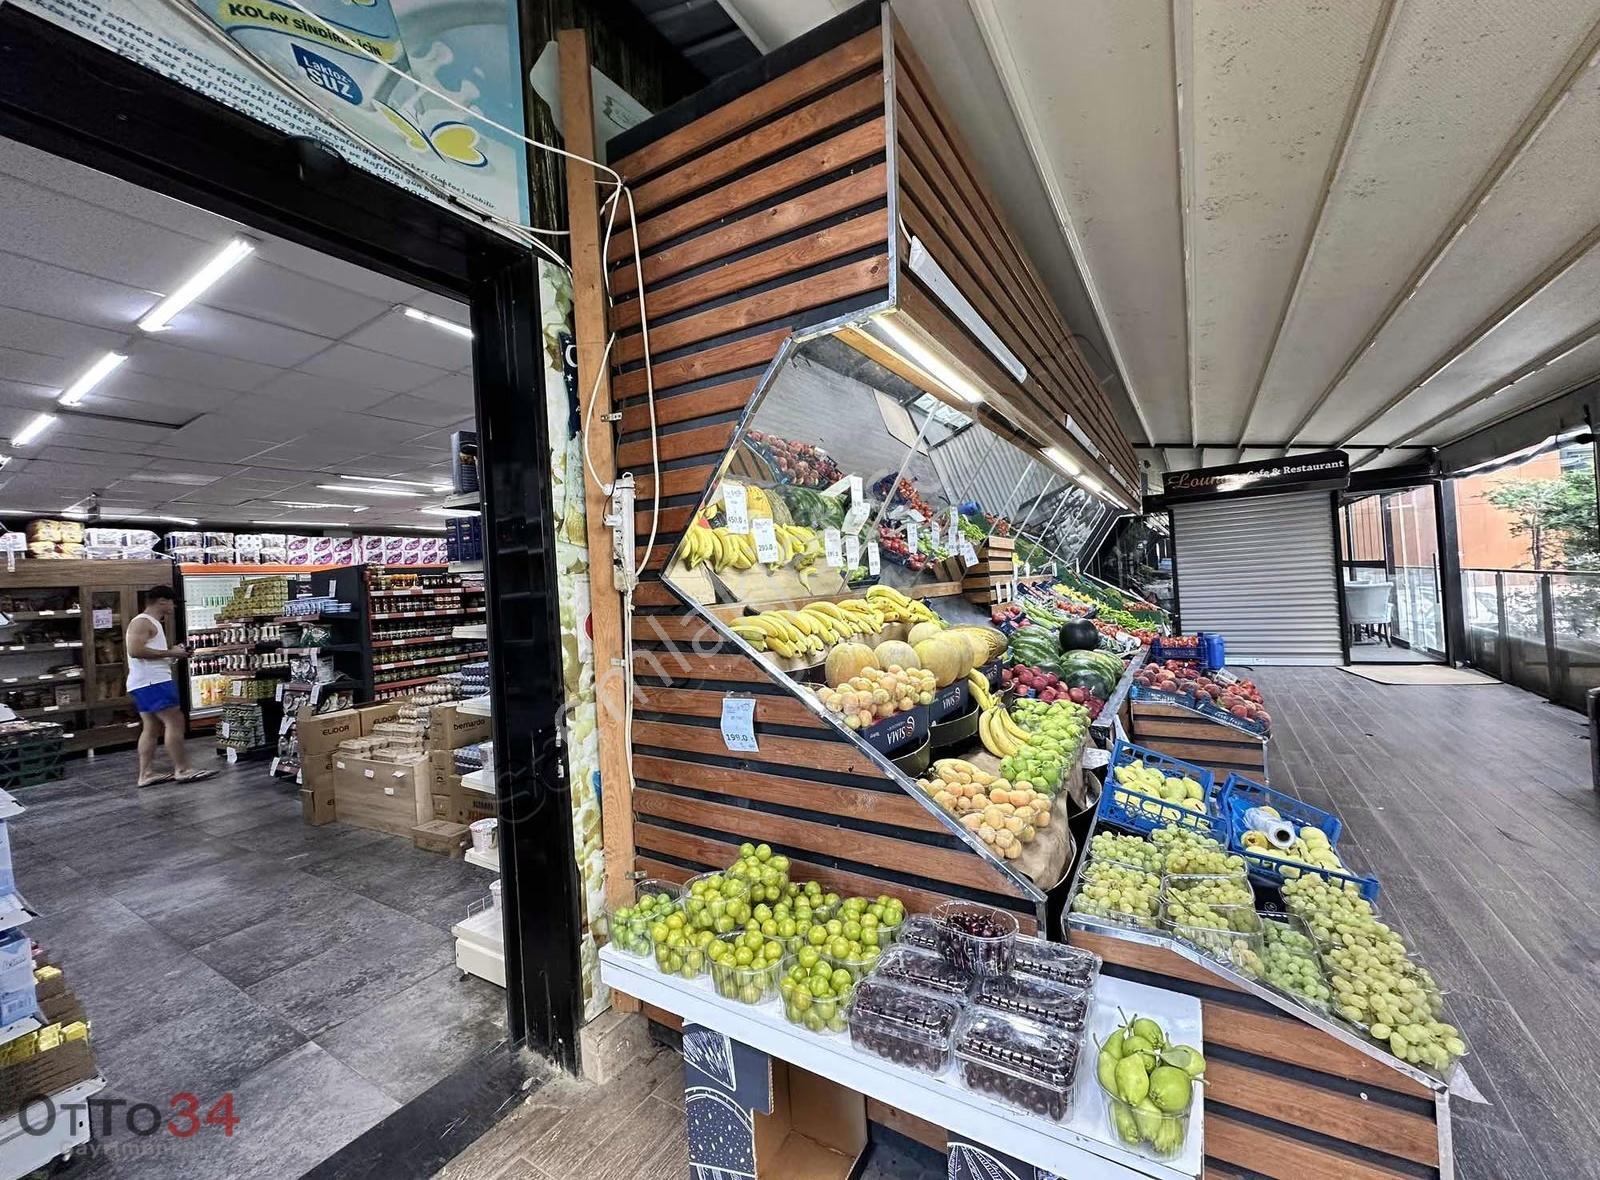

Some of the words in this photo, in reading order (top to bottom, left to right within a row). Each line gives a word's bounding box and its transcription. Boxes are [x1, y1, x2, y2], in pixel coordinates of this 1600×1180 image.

[228, 3, 289, 26] KOLAY
[293, 19, 355, 48] SİNDİR
[1271, 466, 1281, 477] &
[1283, 459, 1345, 475] Restaurant
[453, 717, 486, 732] bernardo
